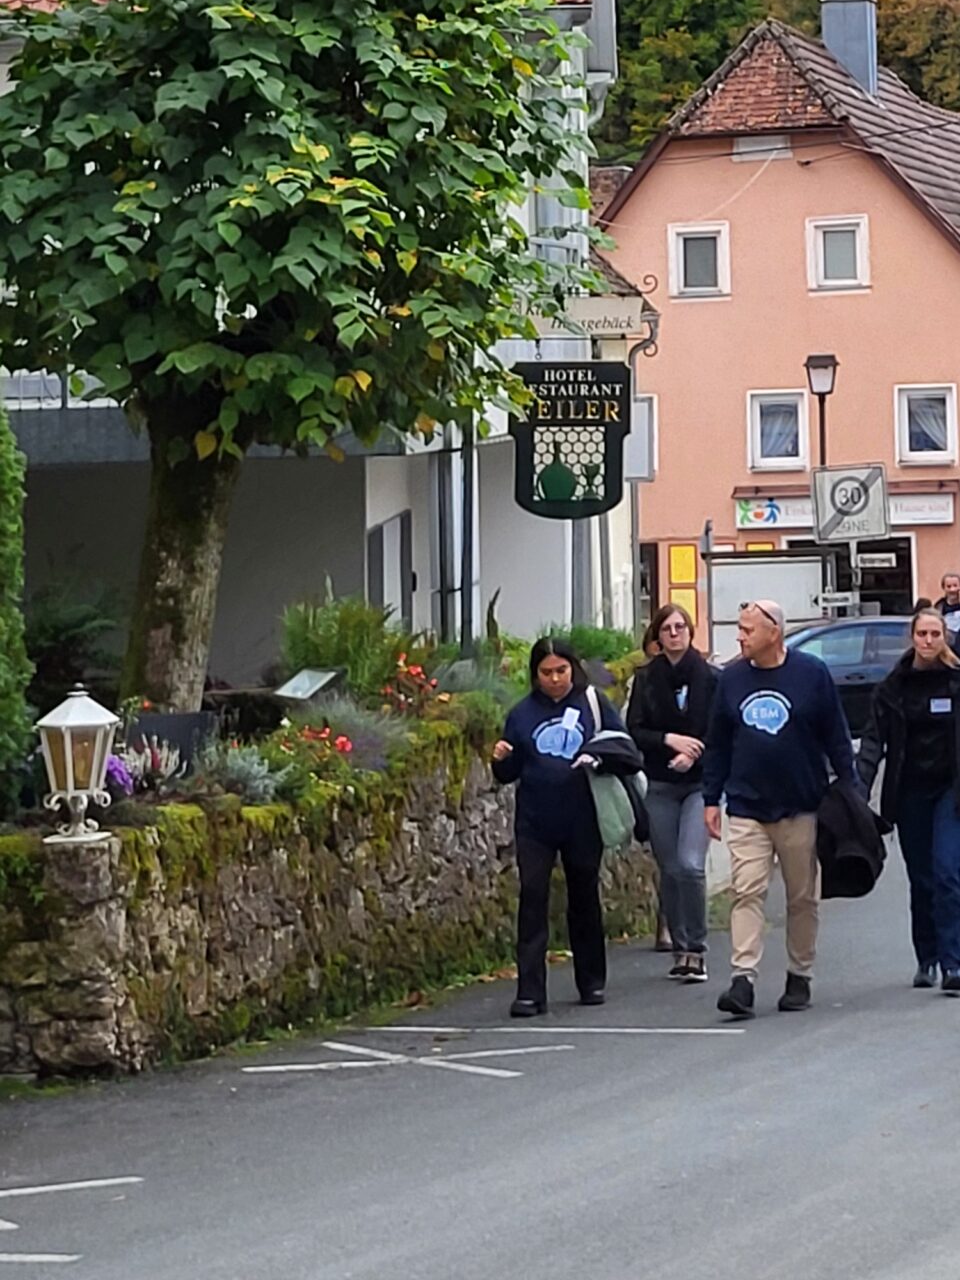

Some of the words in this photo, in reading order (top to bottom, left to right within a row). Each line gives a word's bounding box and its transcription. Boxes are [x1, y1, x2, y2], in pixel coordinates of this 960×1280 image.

[550, 315, 633, 333] Hsgebäck
[543, 368, 598, 382] HOTEL
[528, 383, 624, 397] ESTAURANT
[518, 400, 622, 423] EILER
[838, 486, 862, 507] 30
